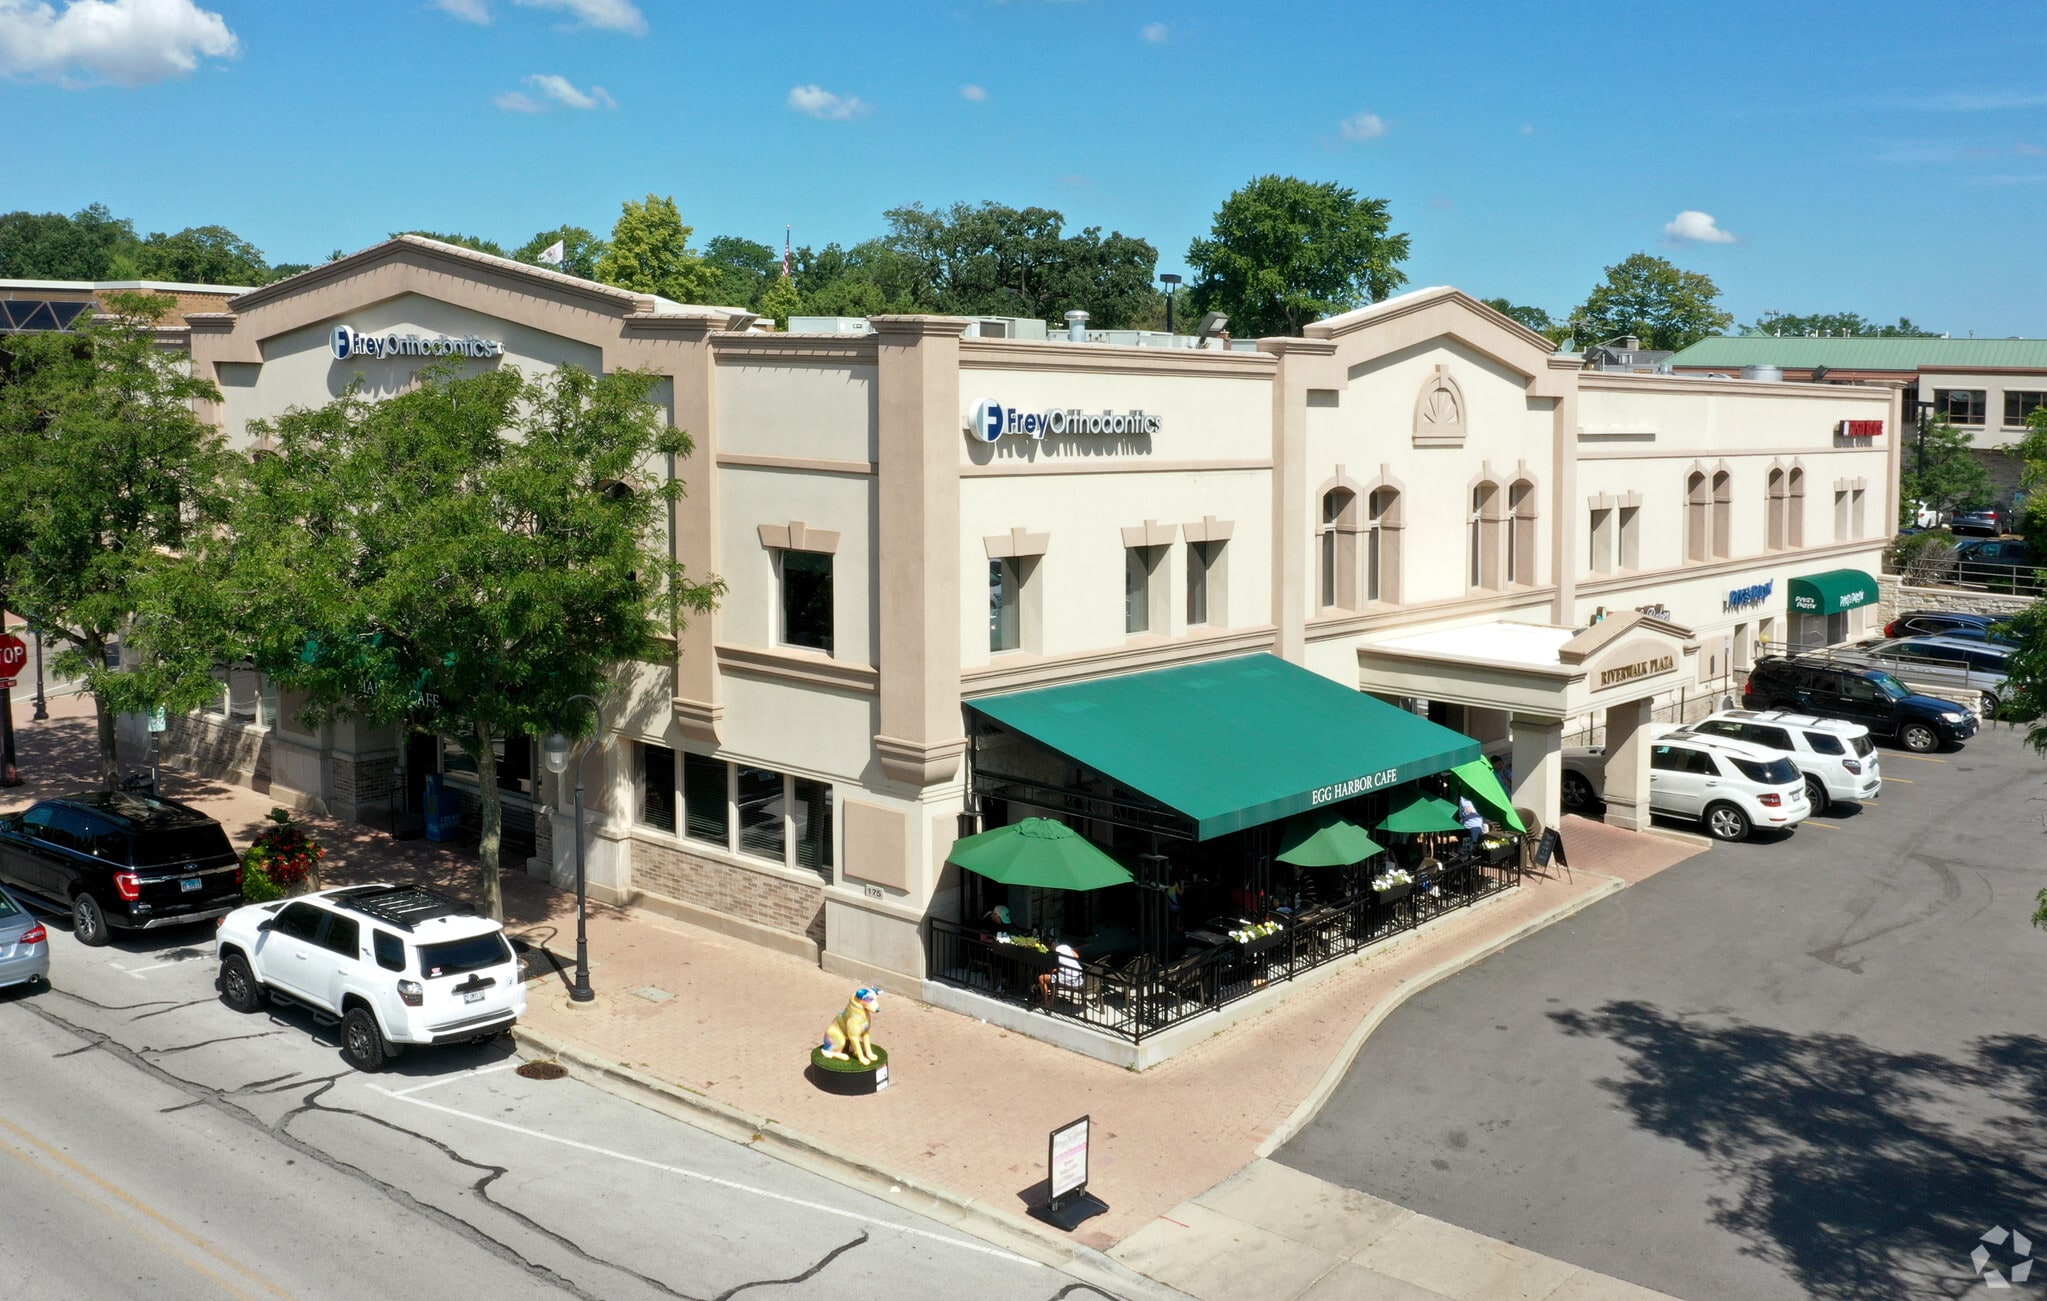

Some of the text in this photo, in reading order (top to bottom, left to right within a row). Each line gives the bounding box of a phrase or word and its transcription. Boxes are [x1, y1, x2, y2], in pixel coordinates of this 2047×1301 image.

[1006, 408, 1048, 439] Frey
[1600, 655, 1674, 686] RIVERWALK PLAZA
[1312, 768, 1398, 805] EGG HARBOR CAFE
[867, 888, 882, 898] 175
